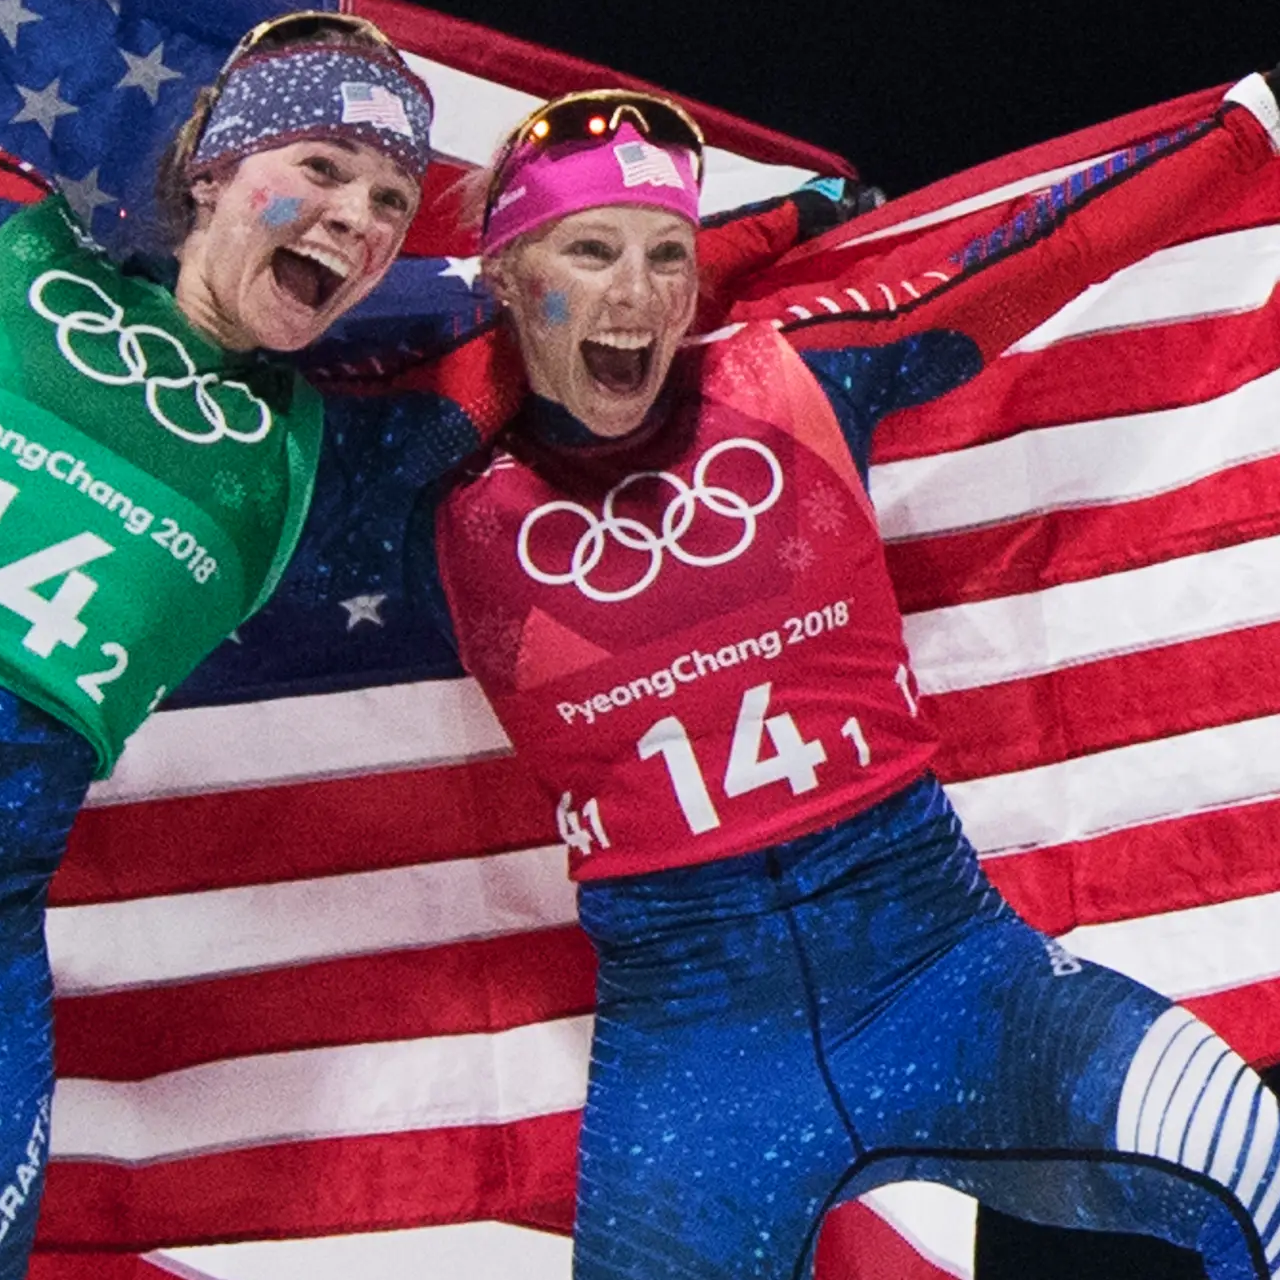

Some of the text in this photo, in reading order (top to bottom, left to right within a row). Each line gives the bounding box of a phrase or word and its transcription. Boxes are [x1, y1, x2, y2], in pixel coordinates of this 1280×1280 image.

[151, 517, 217, 584] 2018
[76, 642, 129, 705] 2
[555, 600, 850, 726] PyeongChang 2018
[636, 680, 871, 836] 14 1
